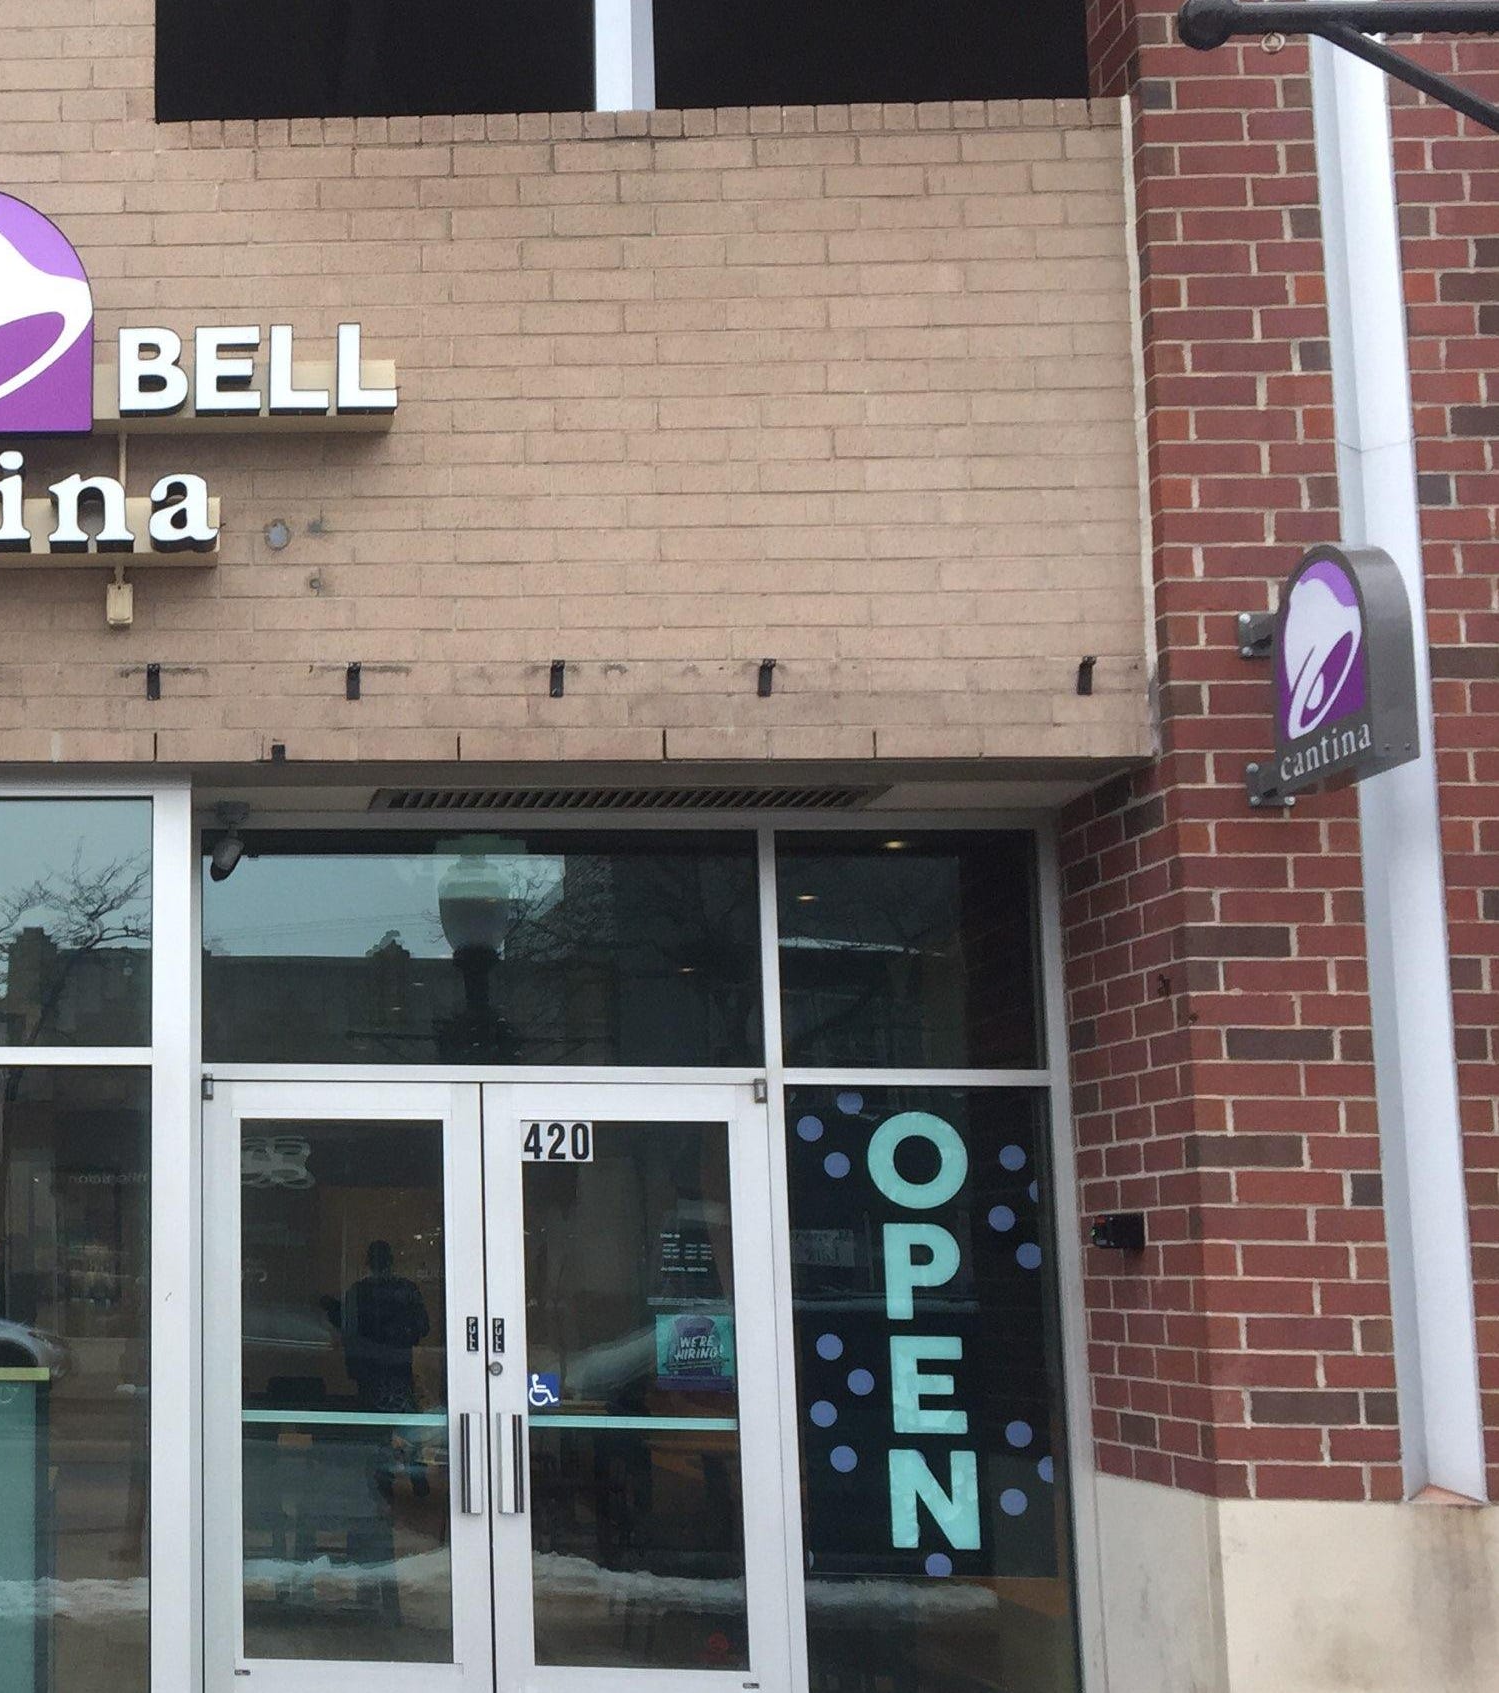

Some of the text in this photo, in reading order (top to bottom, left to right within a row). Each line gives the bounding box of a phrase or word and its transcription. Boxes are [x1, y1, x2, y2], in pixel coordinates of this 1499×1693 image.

[118, 323, 399, 418] BELL
[1280, 723, 1372, 782] cantina
[523, 1122, 590, 1161] 420
[468, 1318, 476, 1350] PULL
[495, 1320, 503, 1352] PULL
[680, 1335, 715, 1348] WE'RE
[867, 1111, 982, 1551] OPEN
